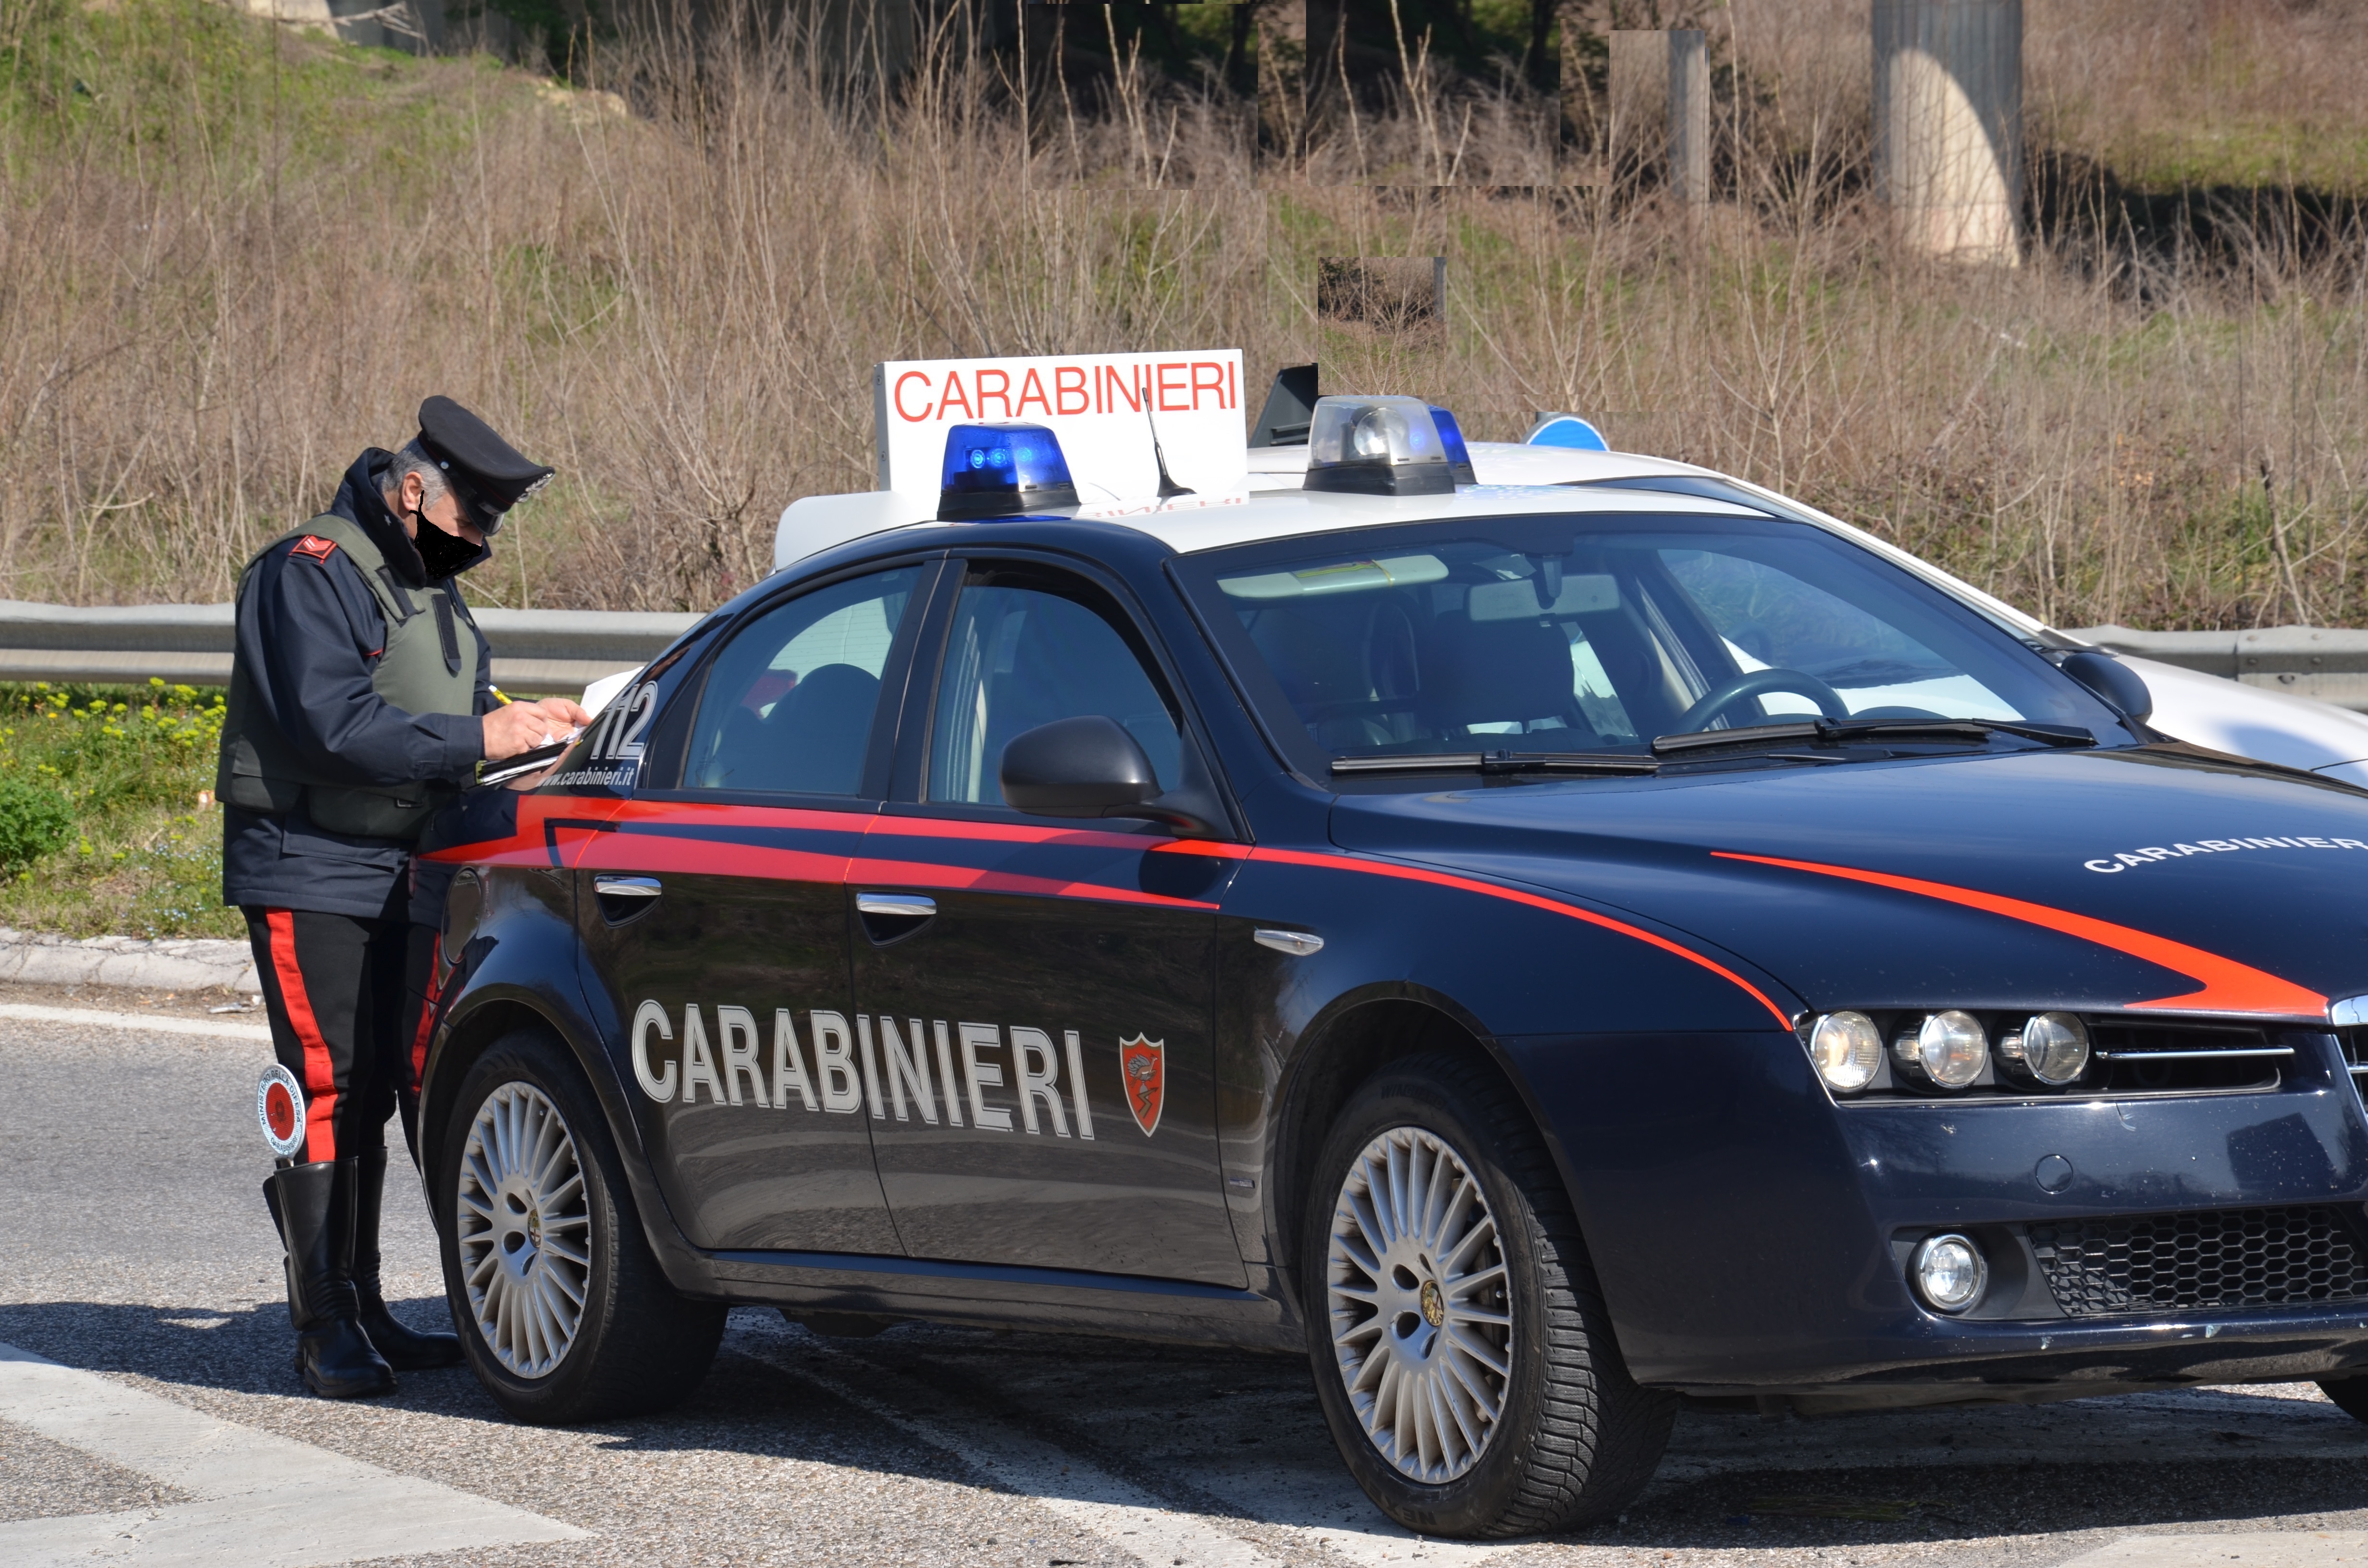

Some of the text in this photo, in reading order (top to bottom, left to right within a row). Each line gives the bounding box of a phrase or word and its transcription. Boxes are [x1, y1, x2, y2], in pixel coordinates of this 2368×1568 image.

[894, 361, 1236, 422] CARABINIERI
[590, 680, 658, 760] 112
[2084, 837, 2368, 872] CARABINIER
[271, 1070, 289, 1086] DELLA
[289, 1084, 301, 1123] DIFESA
[632, 999, 1096, 1140] CARABINIERI
